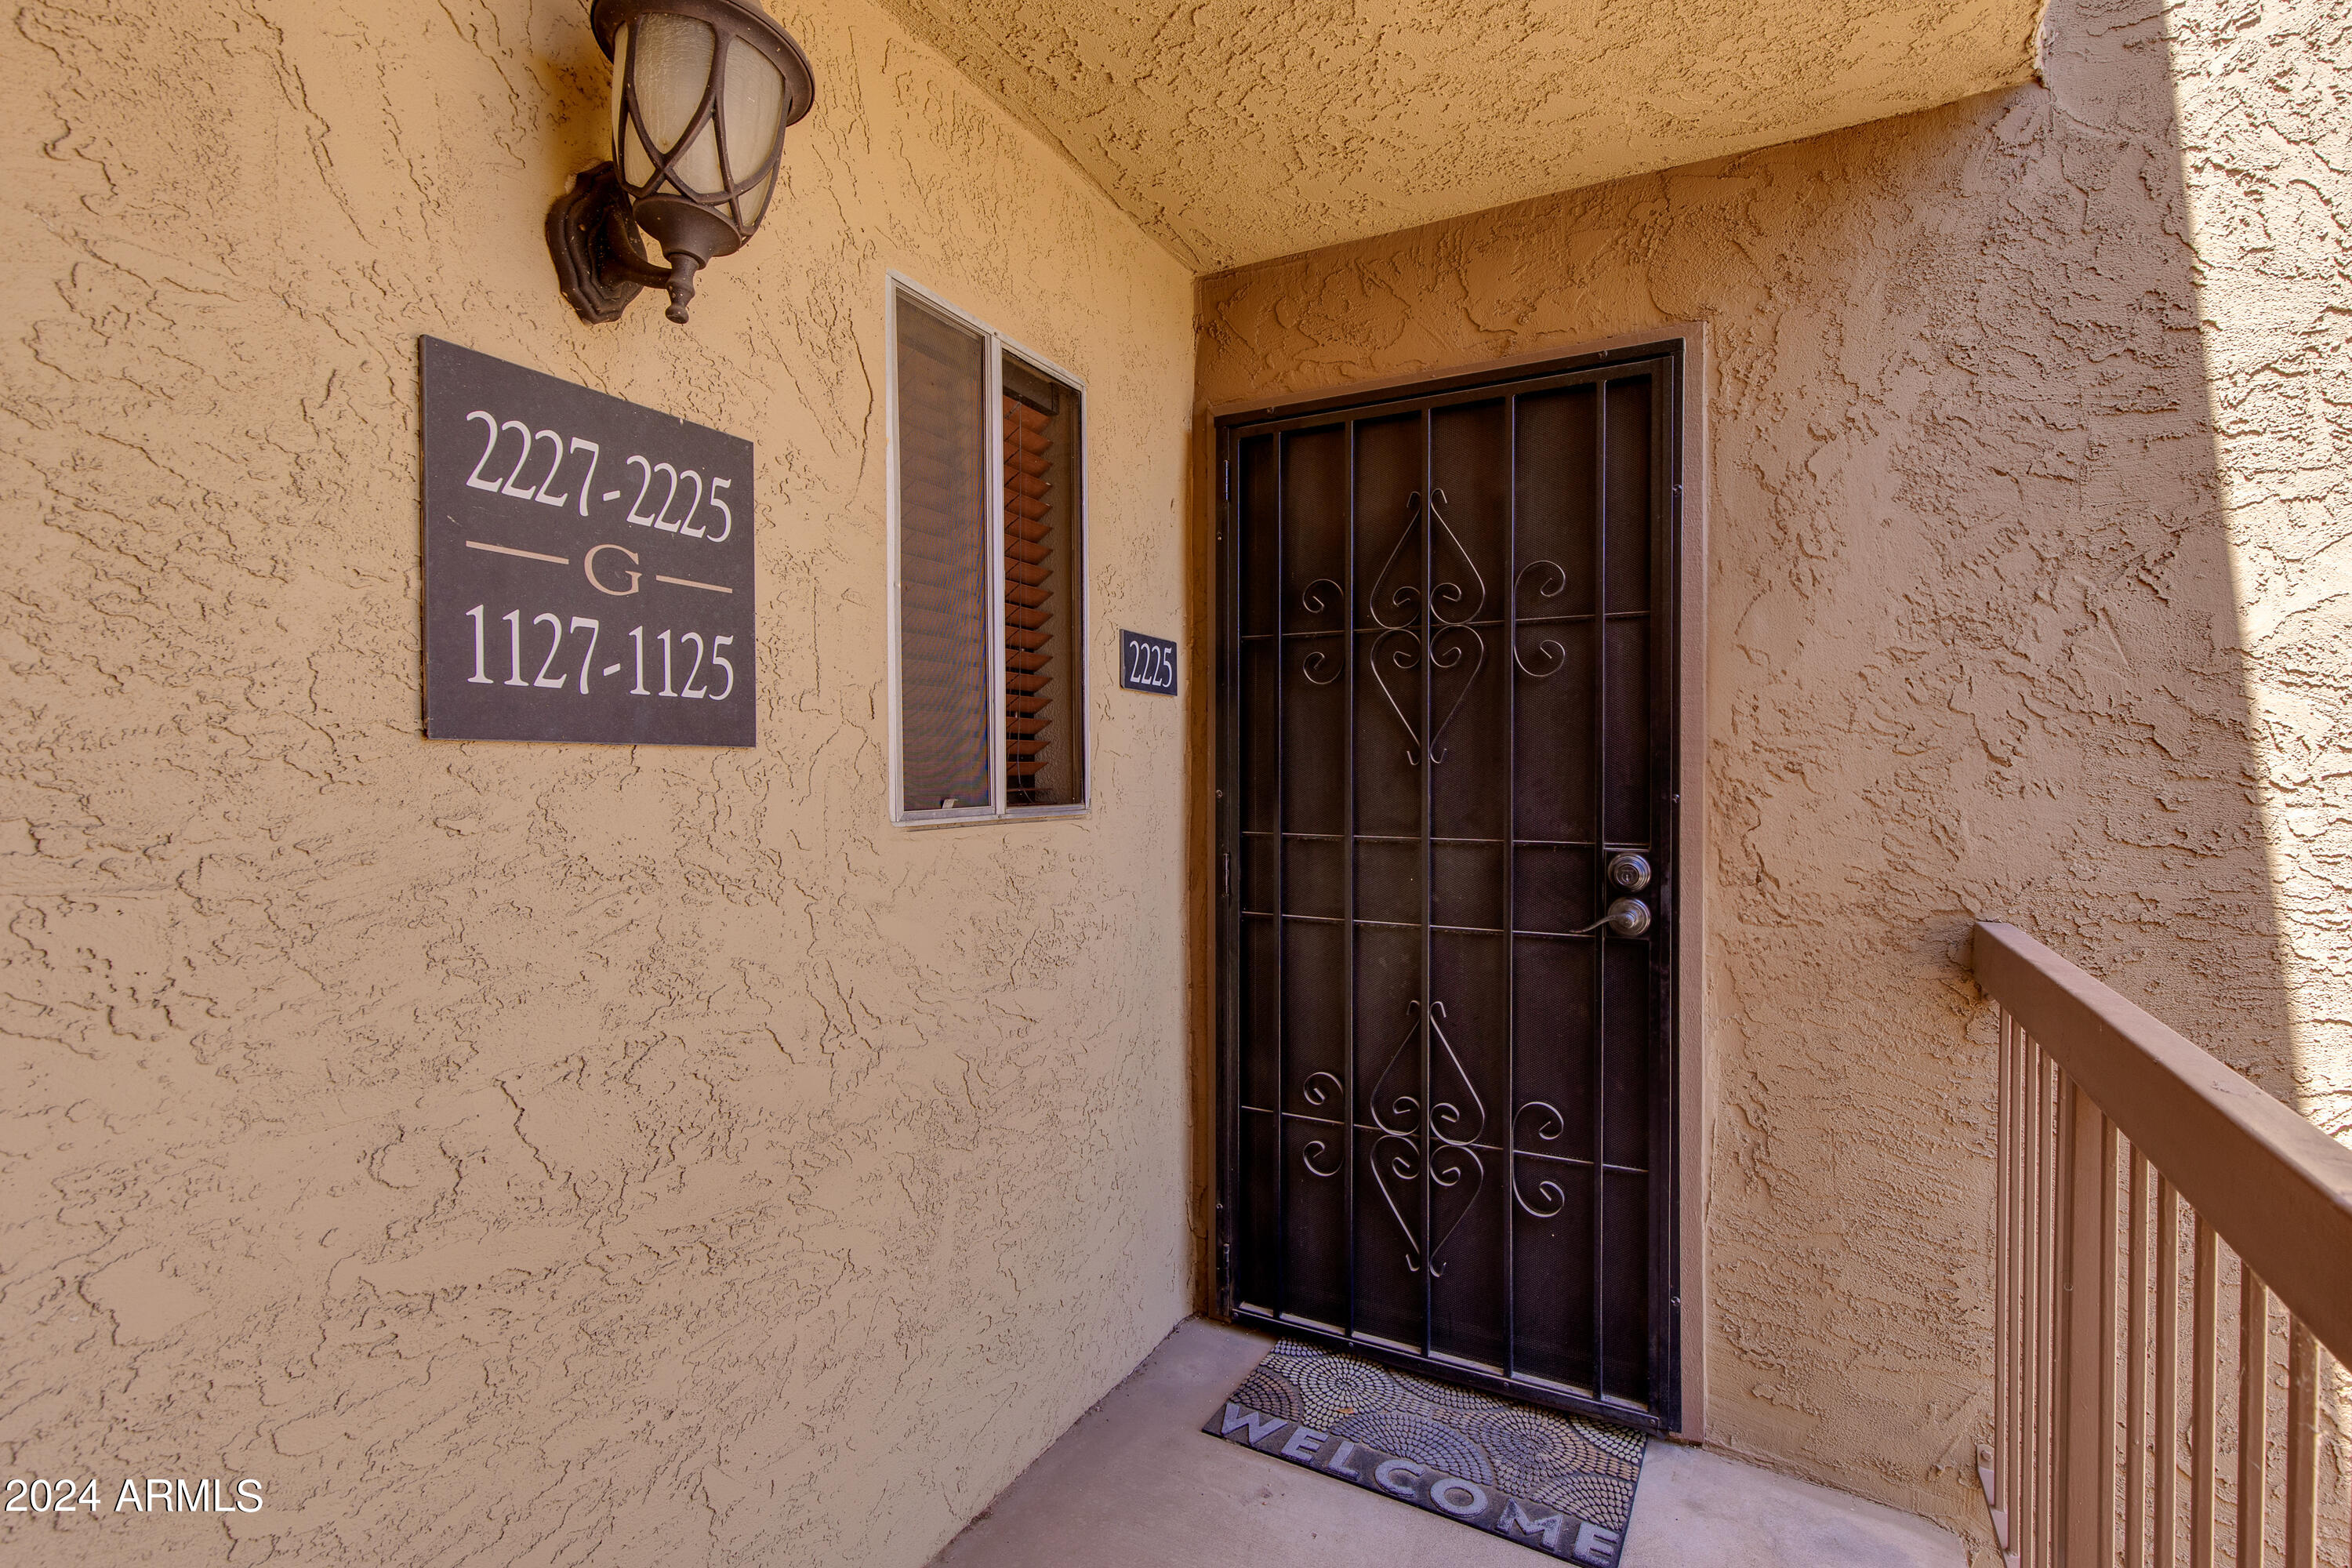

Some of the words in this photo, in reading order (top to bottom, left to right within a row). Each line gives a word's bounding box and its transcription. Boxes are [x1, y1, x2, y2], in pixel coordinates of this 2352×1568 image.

[466, 410, 732, 543] 2227-2225
[583, 543, 643, 597] G
[466, 604, 735, 701] 1127-1125
[1129, 640, 1173, 688] 2225
[1220, 1402, 1621, 1567] WELCOME
